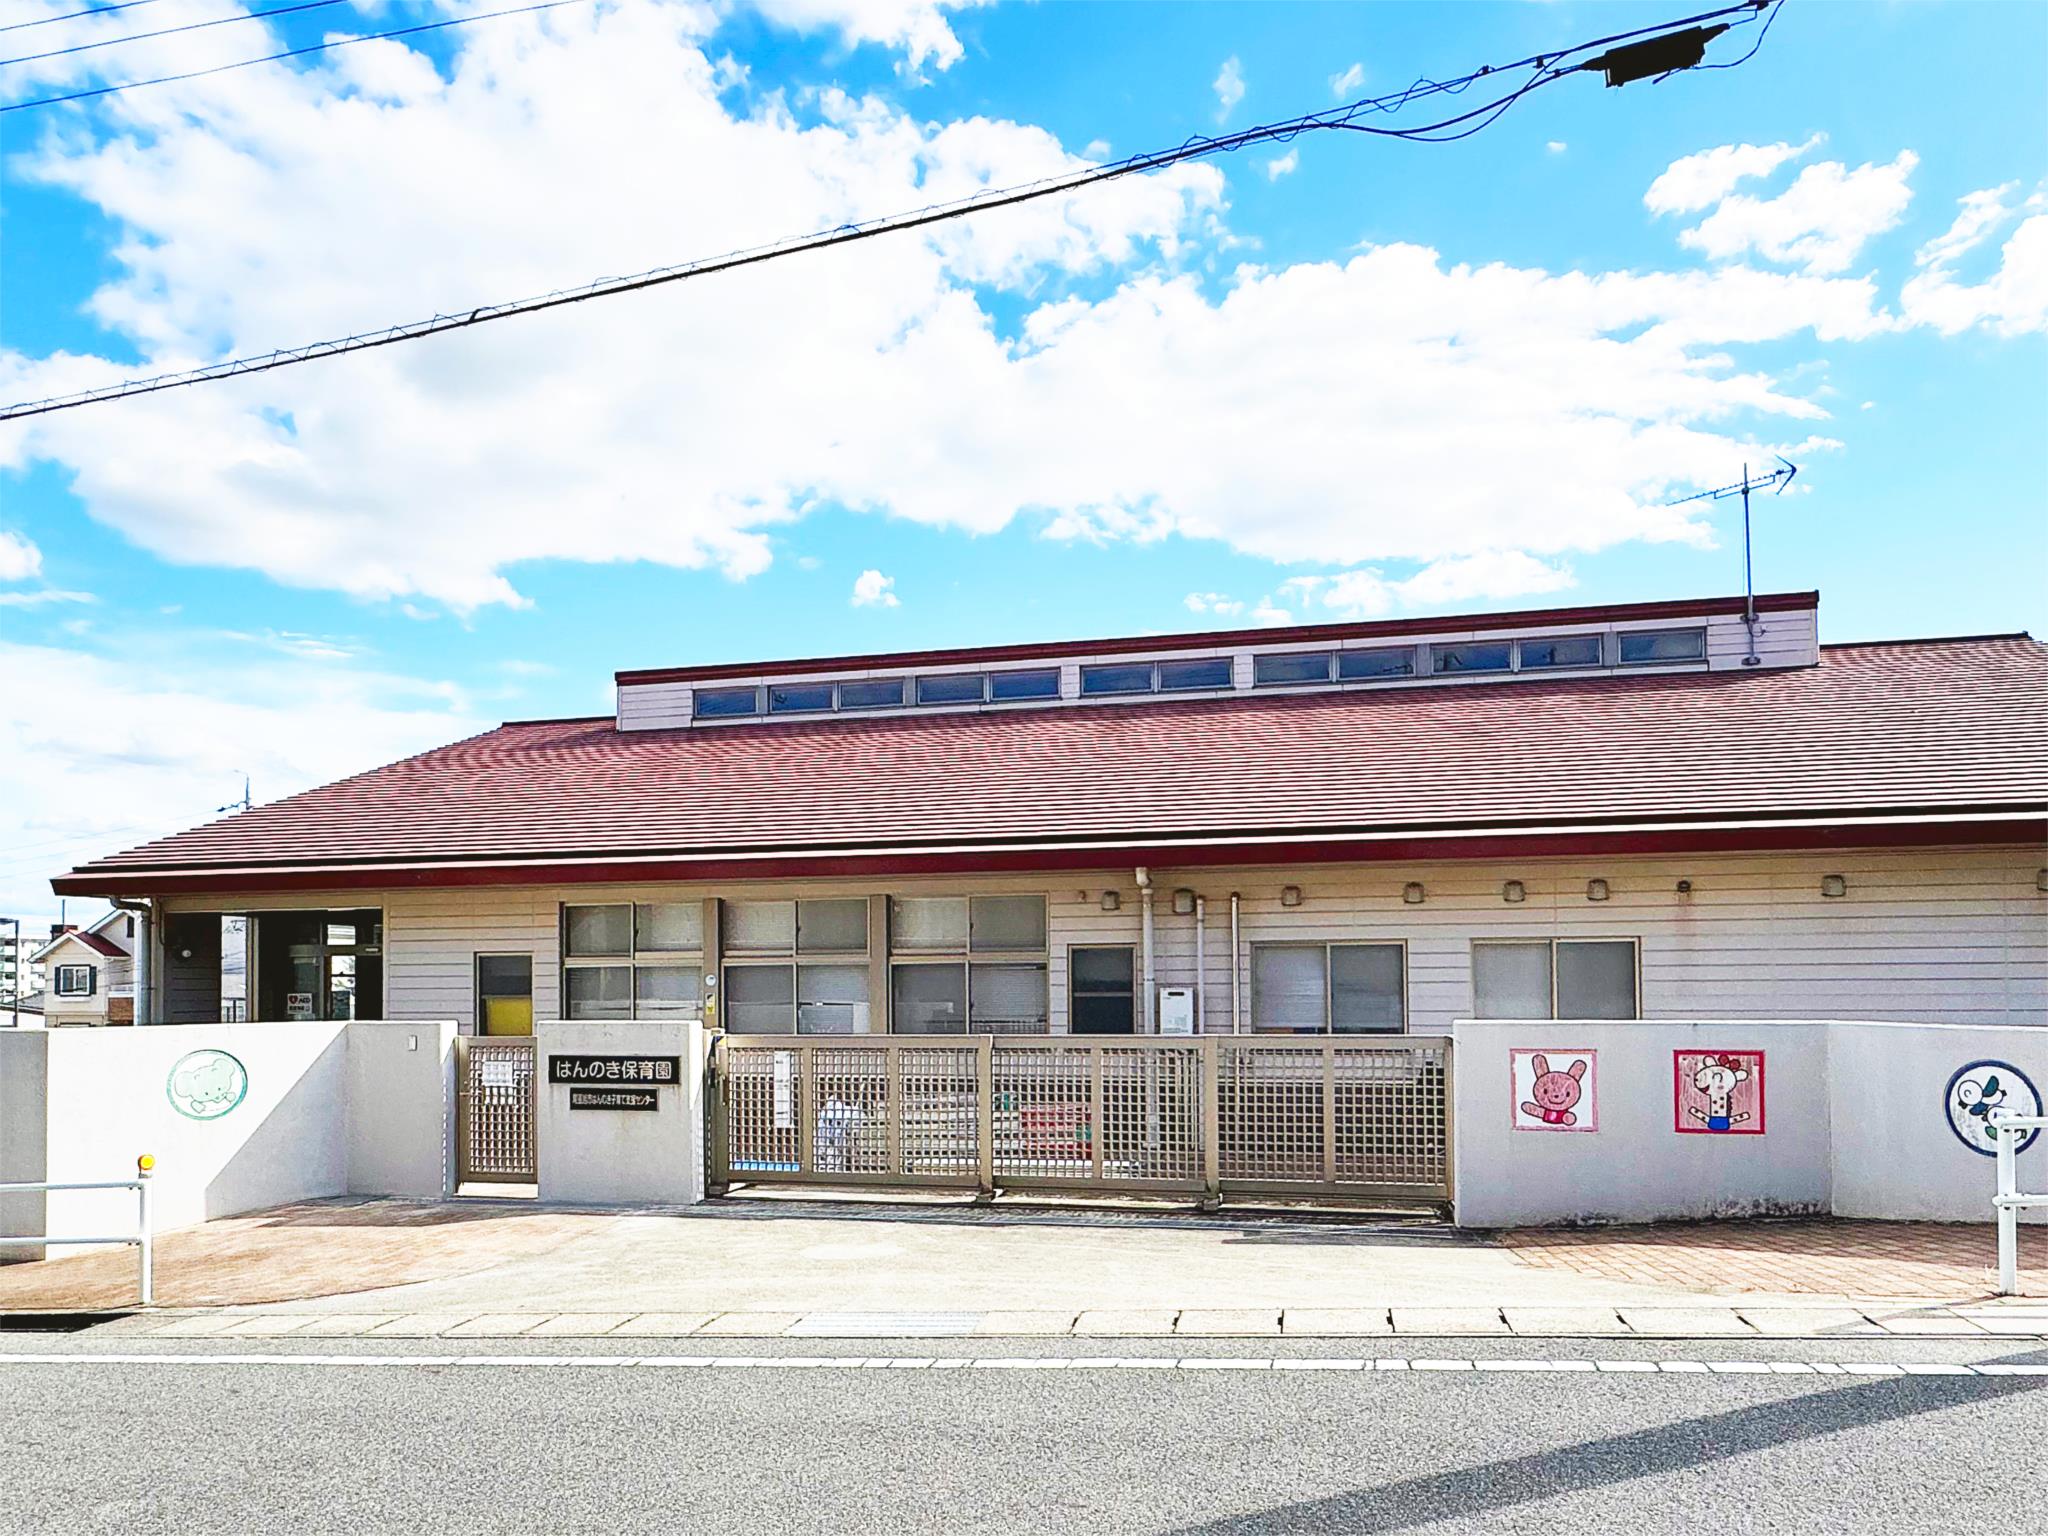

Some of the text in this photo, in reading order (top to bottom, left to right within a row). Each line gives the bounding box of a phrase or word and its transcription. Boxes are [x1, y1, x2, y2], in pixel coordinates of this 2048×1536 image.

[556, 1060, 672, 1080] はんのき保育園
